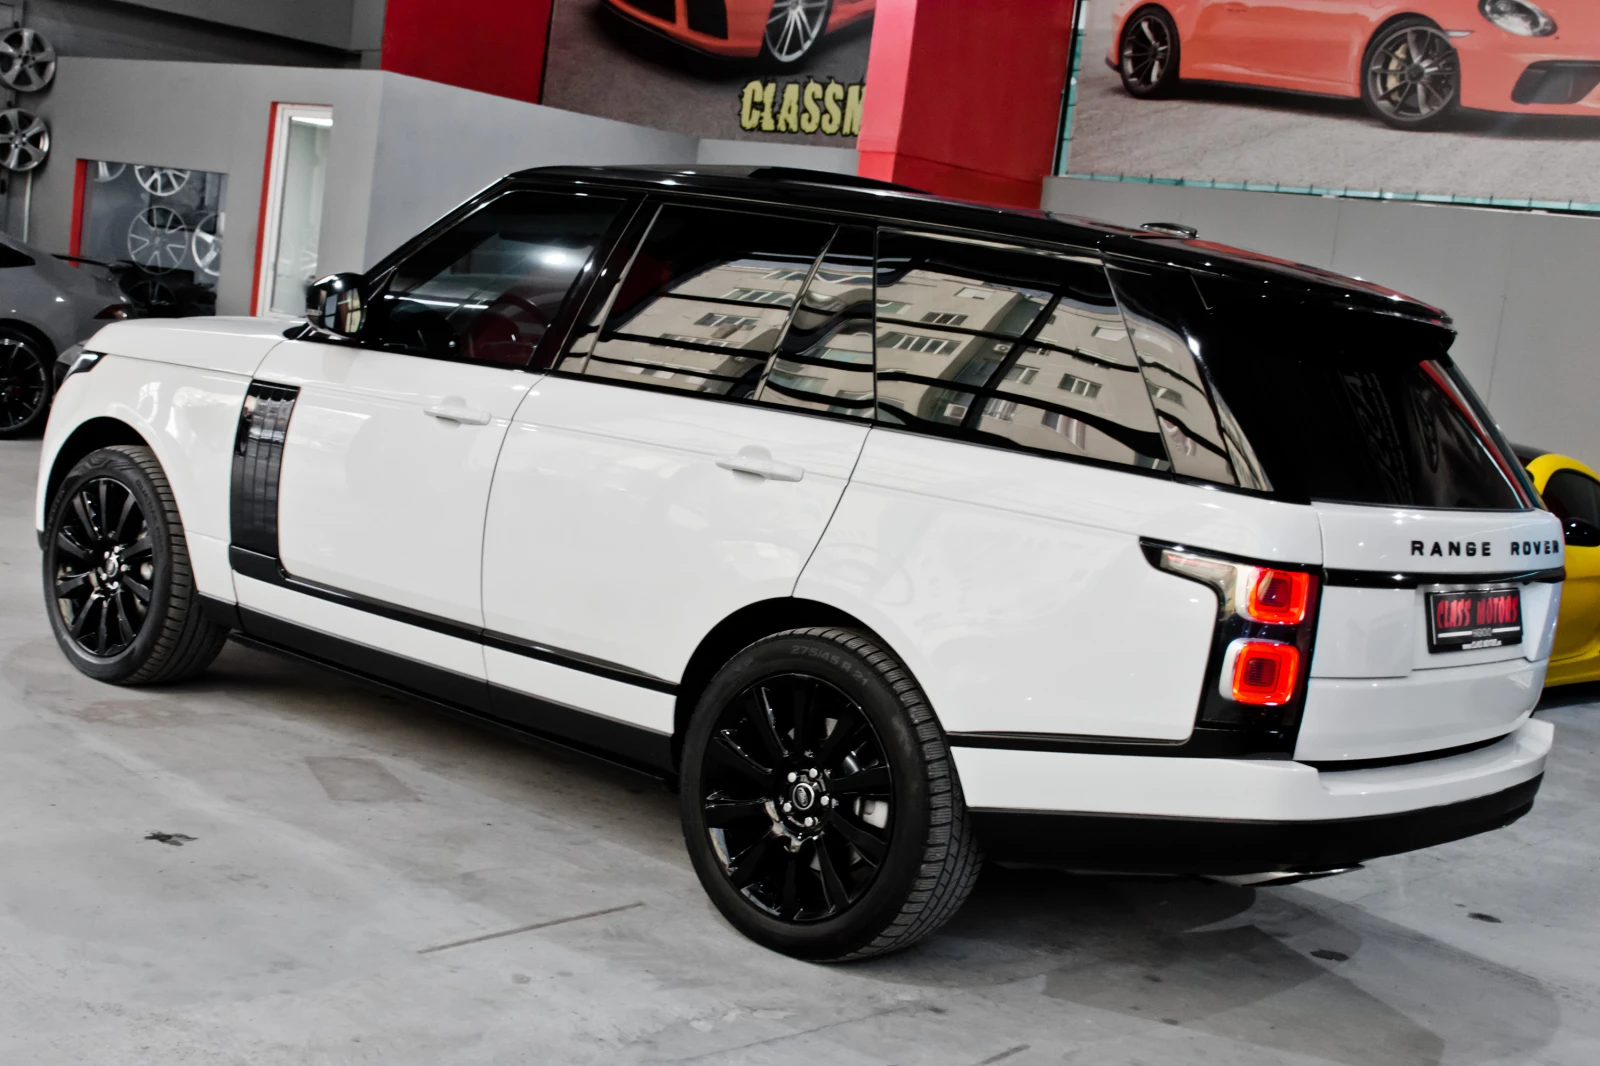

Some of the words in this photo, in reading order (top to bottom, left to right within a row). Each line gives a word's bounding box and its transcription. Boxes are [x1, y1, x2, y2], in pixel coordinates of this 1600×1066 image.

[1411, 540, 1491, 556] RANGE
[1510, 540, 1560, 555] ROVER
[1437, 598, 1471, 628] CLASS
[791, 645, 840, 665] 275/45
[842, 661, 852, 672] R
